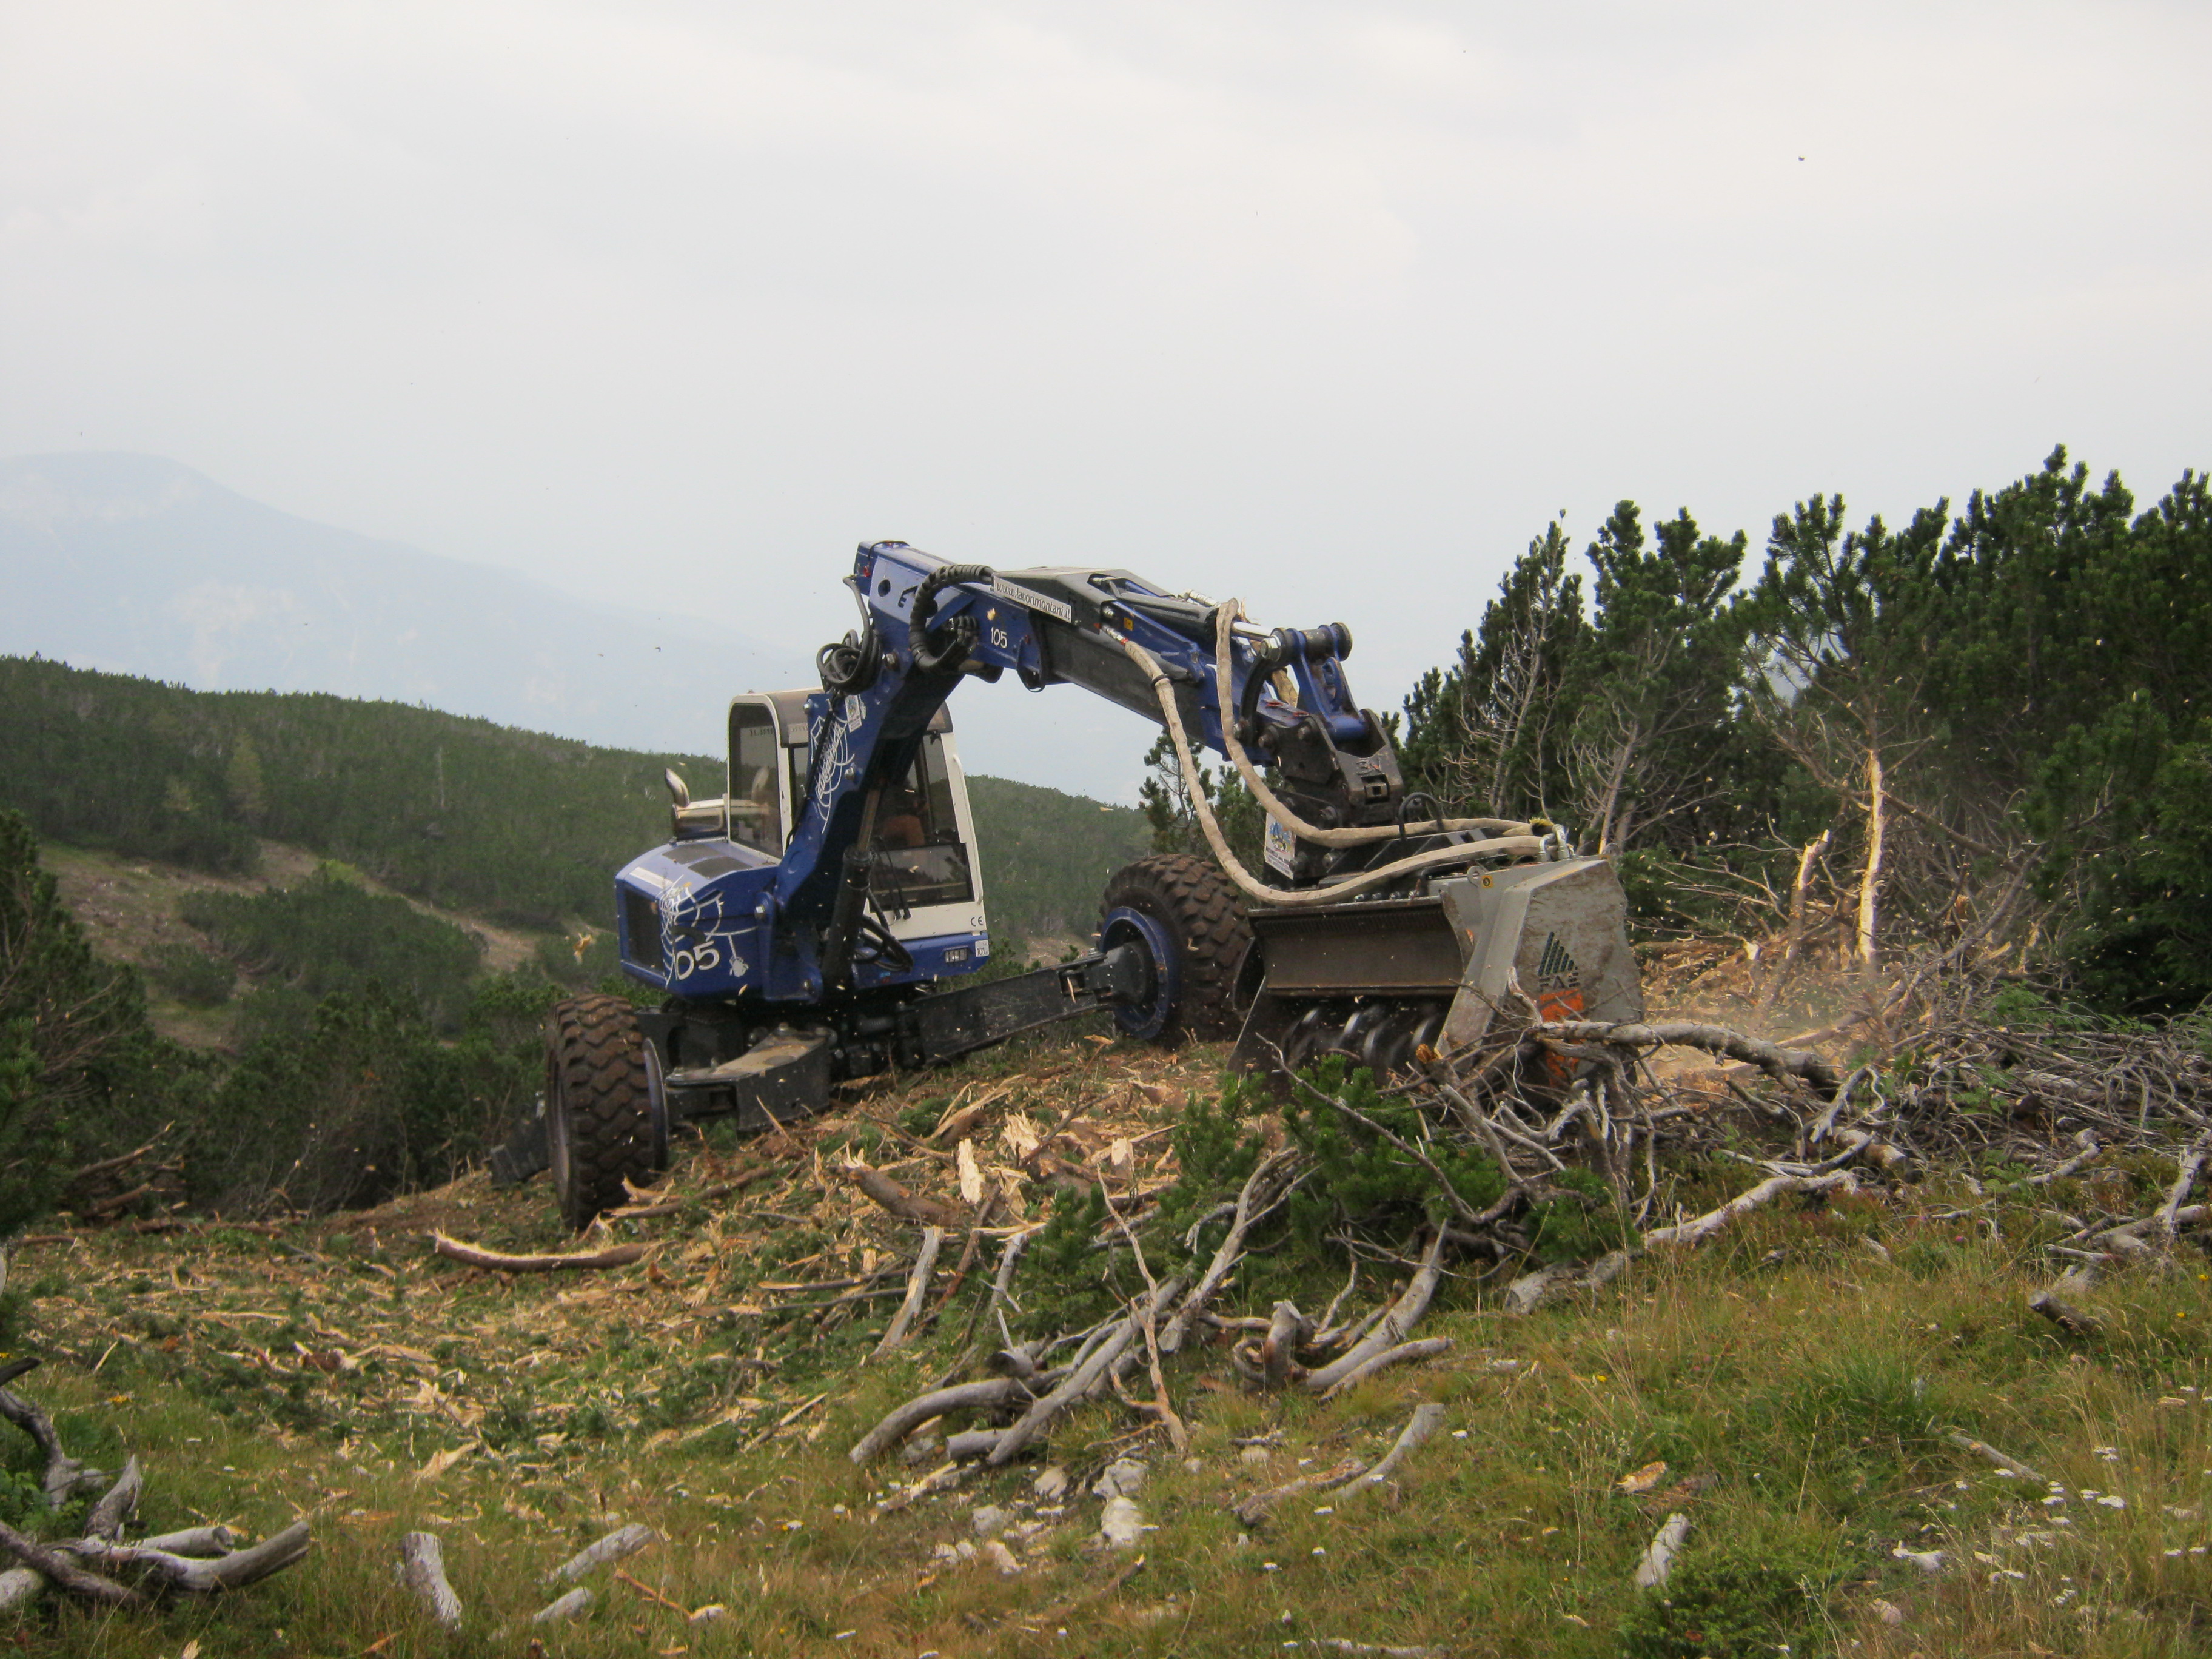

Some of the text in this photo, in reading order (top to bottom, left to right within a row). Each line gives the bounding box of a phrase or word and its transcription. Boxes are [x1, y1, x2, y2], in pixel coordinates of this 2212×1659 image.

[996, 583, 1070, 620] www.lavorimontani.it
[991, 626, 1007, 649] 105
[1538, 971, 1580, 992] FAE
